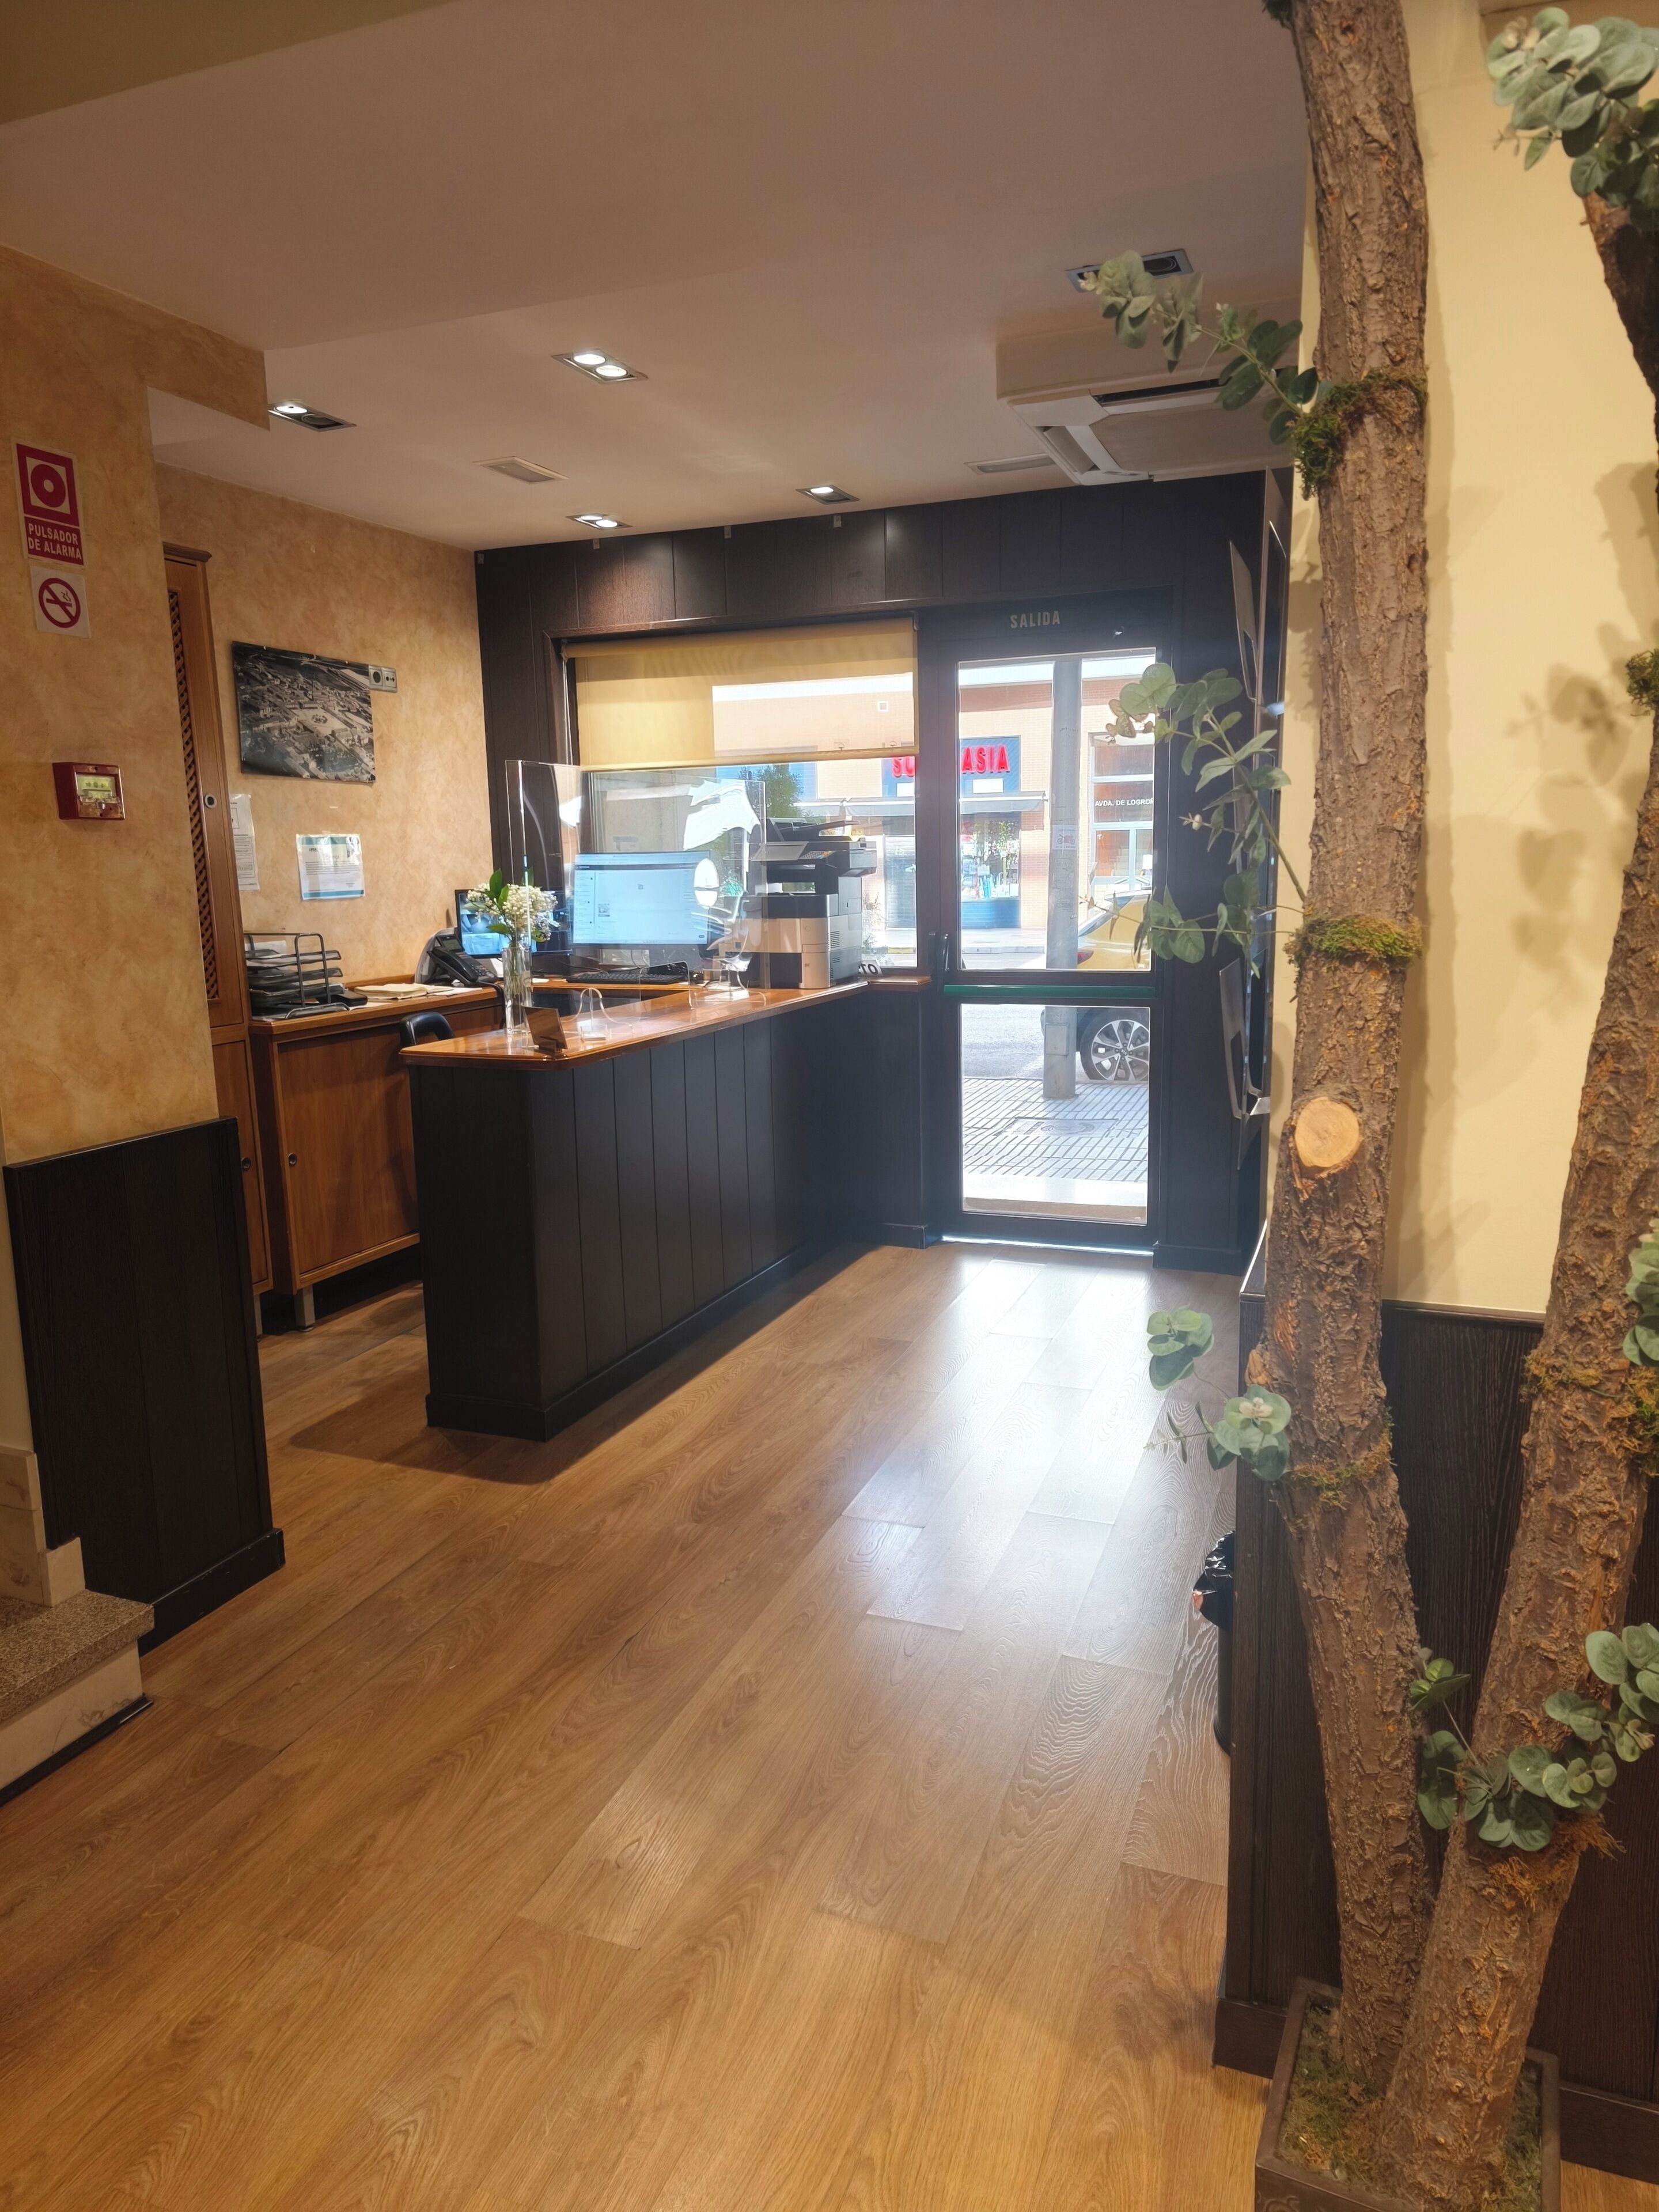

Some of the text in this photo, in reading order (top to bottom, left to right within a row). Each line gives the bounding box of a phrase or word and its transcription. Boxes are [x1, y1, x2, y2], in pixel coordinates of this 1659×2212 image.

[28, 522, 78, 546] PULSADOR
[28, 537, 82, 560] DE ALARMA
[1010, 611, 1060, 628] SALIDA
[961, 745, 1009, 773] ASIA
